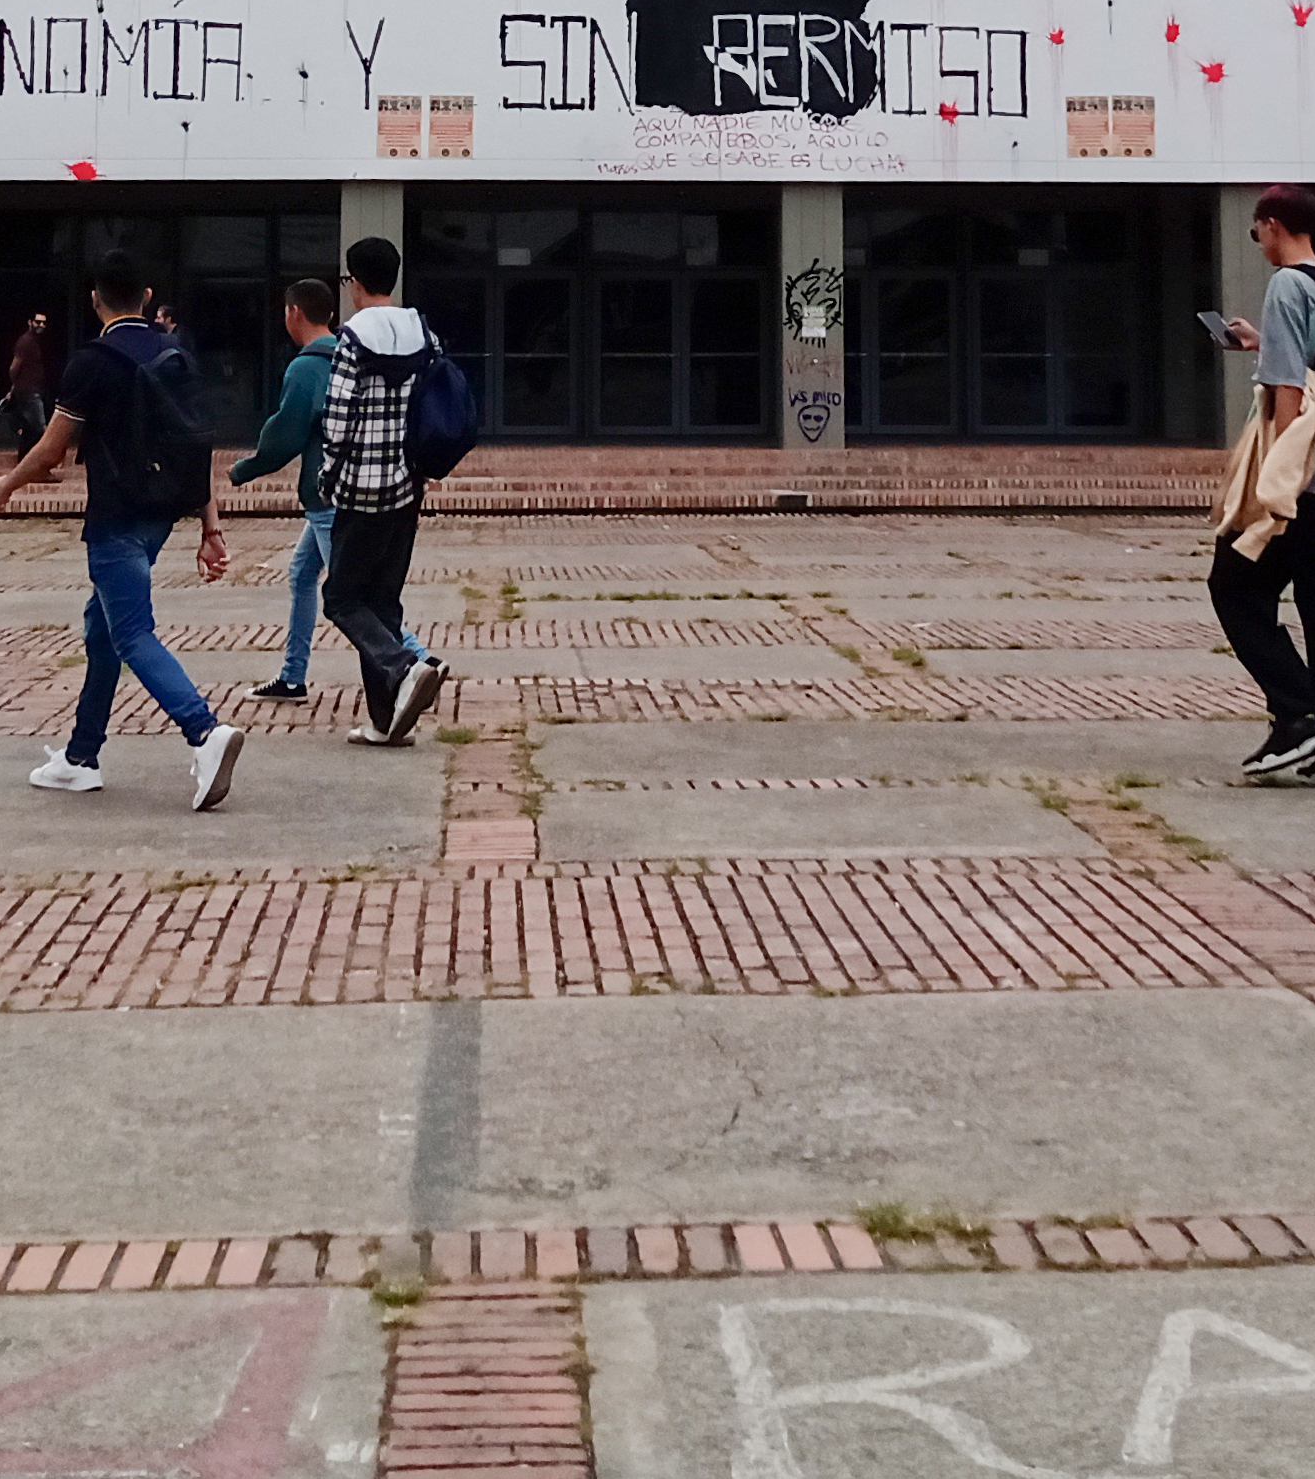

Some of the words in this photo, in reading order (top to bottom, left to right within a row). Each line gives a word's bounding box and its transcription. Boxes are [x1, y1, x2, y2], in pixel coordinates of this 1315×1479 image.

[345, 17, 386, 110] Y
[500, 14, 638, 115] SIN
[704, 13, 1027, 119] PERMISO
[694, 115, 762, 130] NADIE
[866, 132, 889, 147] LO
[636, 152, 677, 170] QUE
[725, 151, 784, 168] SABE
